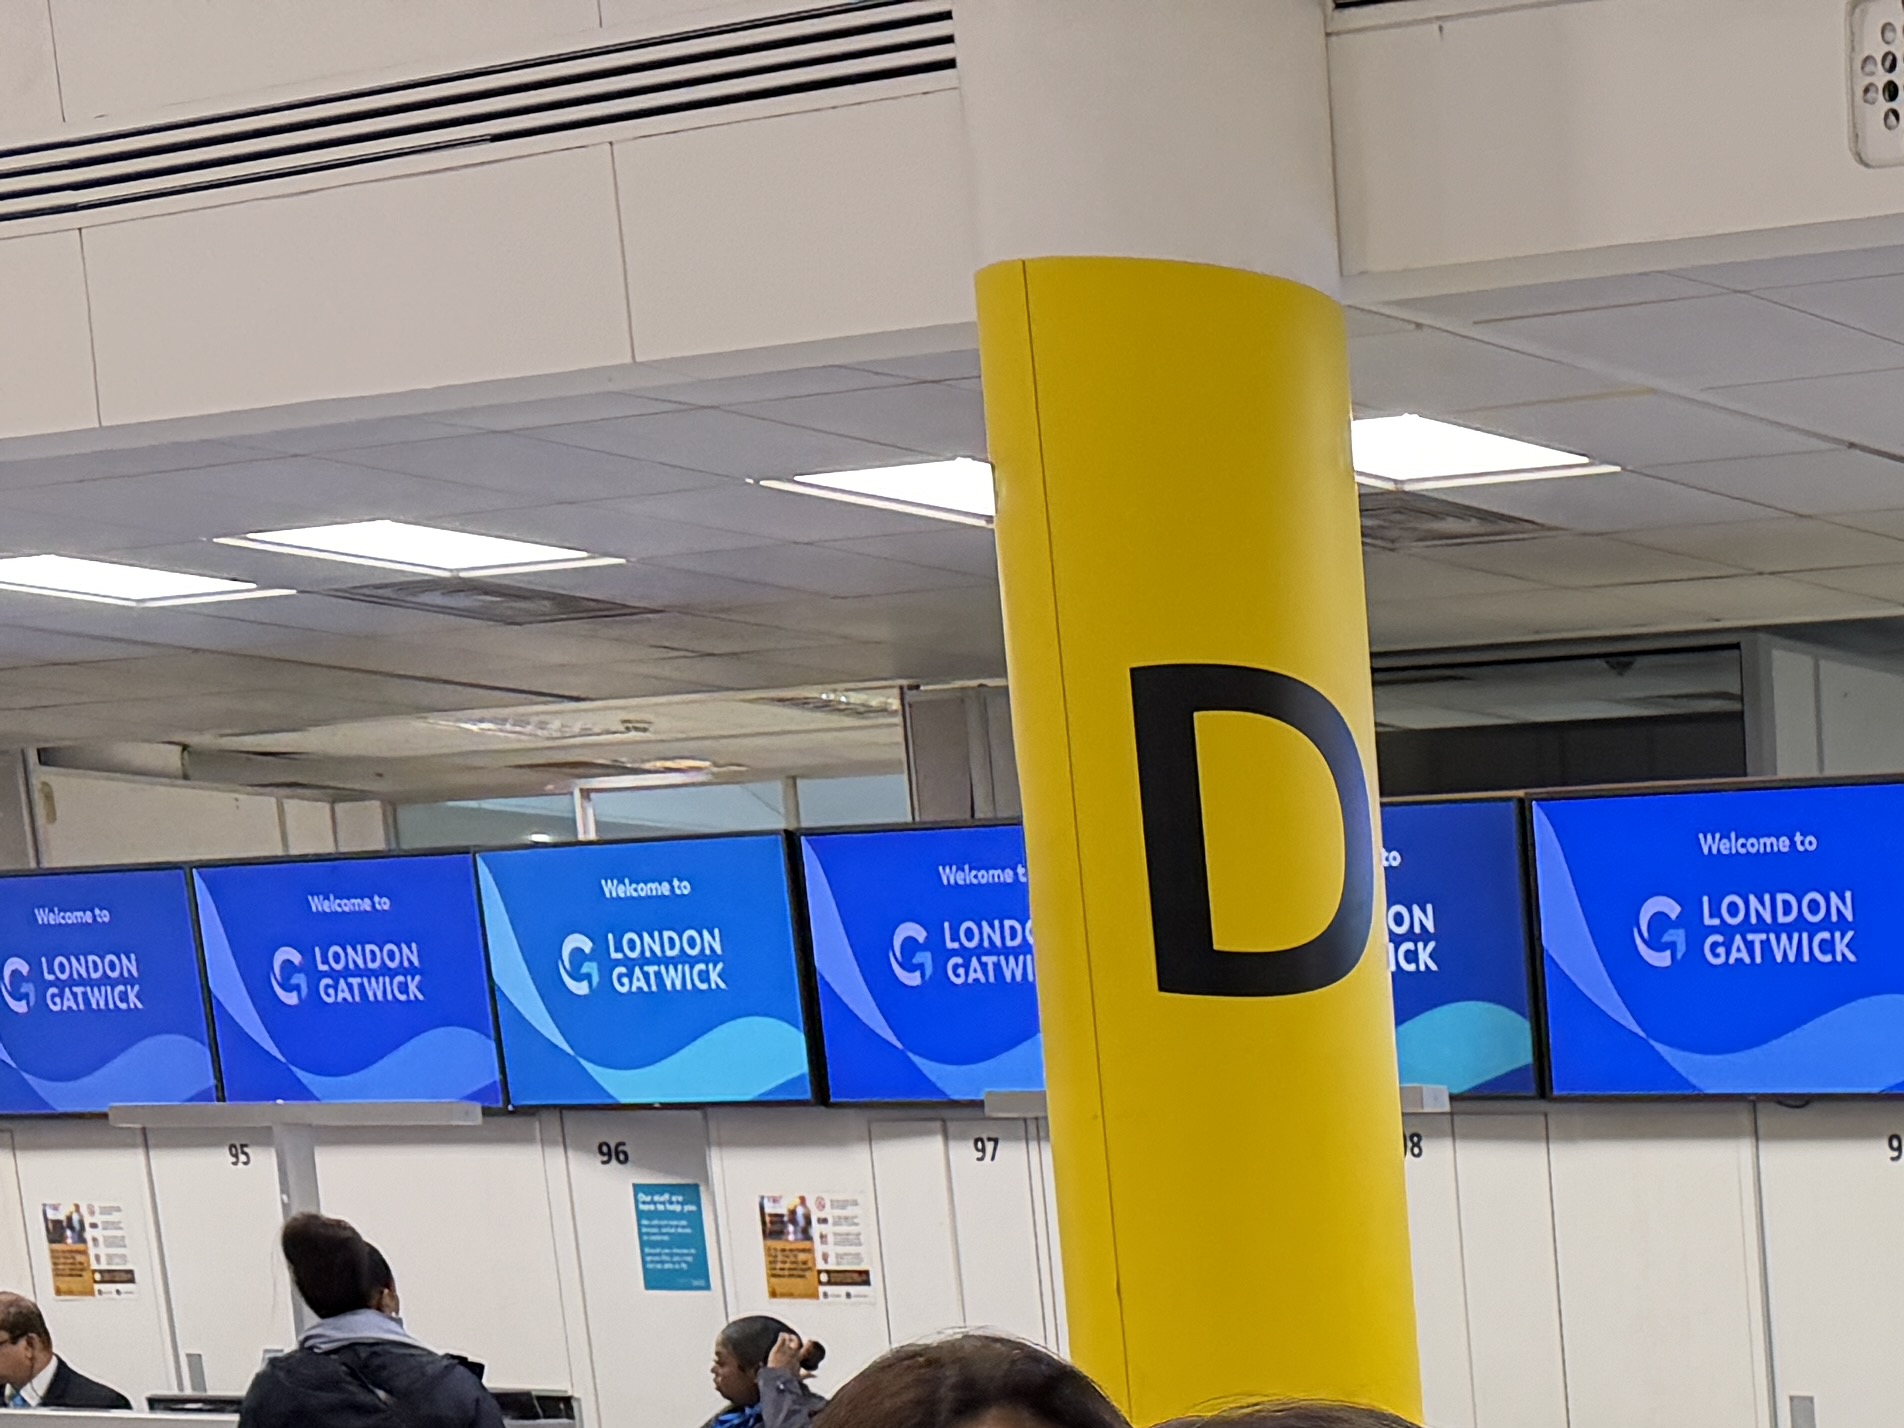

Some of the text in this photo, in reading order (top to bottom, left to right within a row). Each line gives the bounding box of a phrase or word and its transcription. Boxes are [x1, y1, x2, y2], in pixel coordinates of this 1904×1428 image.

[1129, 663, 1375, 998] D
[1698, 831, 1818, 855] Welcome to
[600, 877, 691, 898] Welcome to
[938, 864, 1028, 886] Welcome t
[34, 907, 110, 925] Welcome to
[308, 893, 391, 912] Welcome to
[1702, 890, 1854, 926] LONDON
[607, 928, 723, 959] LONDON
[943, 918, 1034, 949] LOND
[1703, 930, 1857, 965] GATWICK
[41, 953, 138, 980] LONDON
[314, 941, 420, 971] LONDON
[946, 953, 1035, 985] GATWI
[318, 974, 425, 1003] GATWICK
[612, 961, 728, 993] GATWICK
[46, 984, 144, 1012] GATWICK
[228, 1143, 251, 1166] 95
[597, 1141, 629, 1165] 96
[973, 1136, 999, 1162] 97
